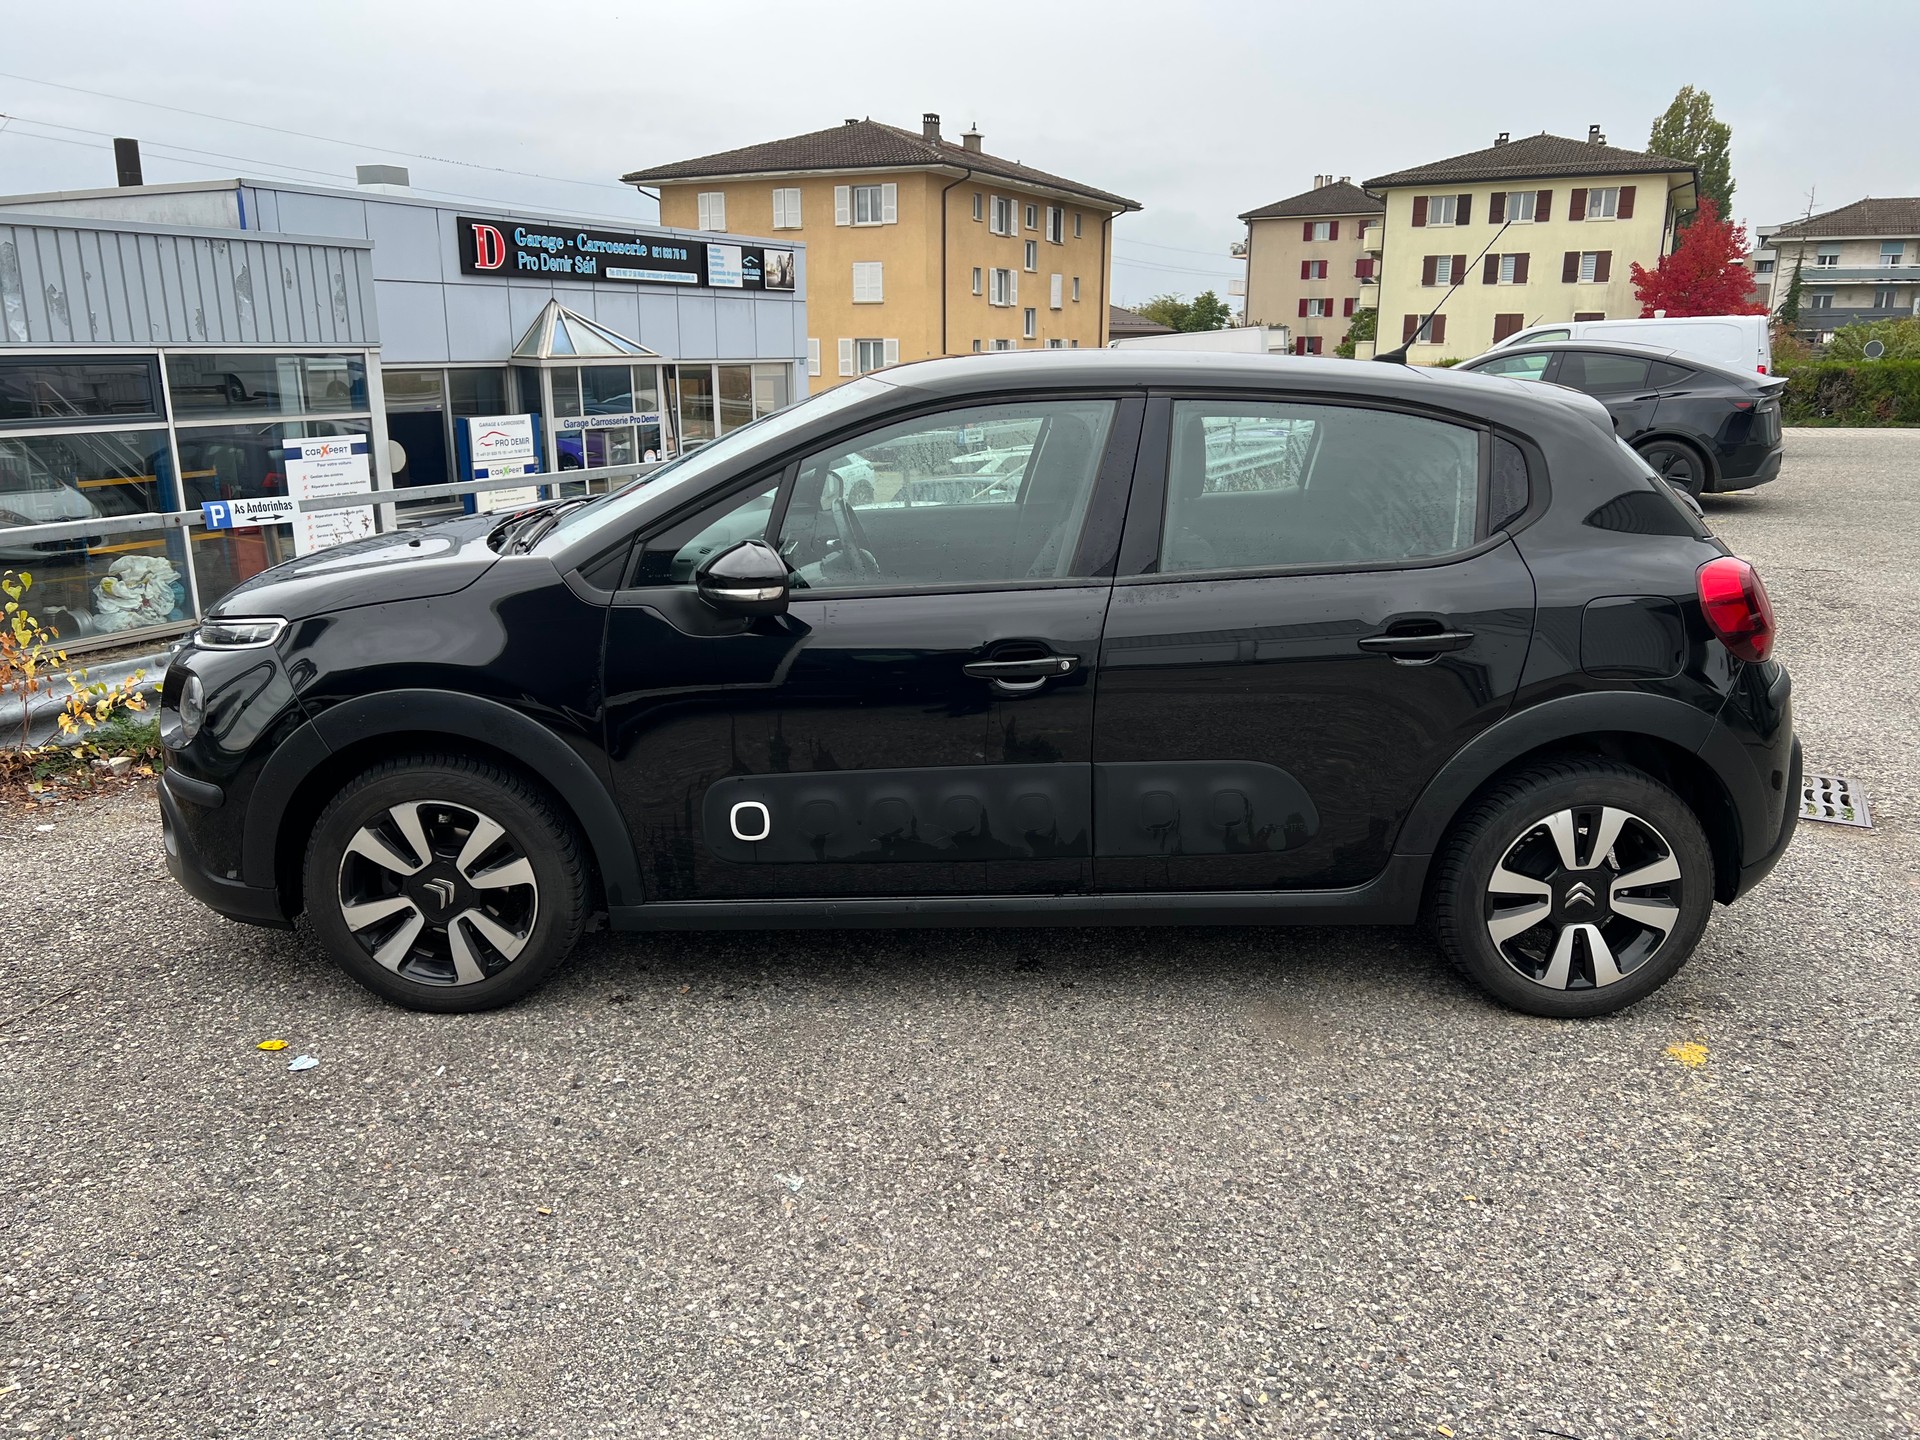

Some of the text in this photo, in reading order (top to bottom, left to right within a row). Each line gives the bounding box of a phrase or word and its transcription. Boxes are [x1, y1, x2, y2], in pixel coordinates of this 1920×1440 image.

[471, 223, 506, 270] D
[514, 227, 565, 254] Garage
[576, 233, 648, 257] Carrosserie
[517, 251, 539, 271] Pro
[540, 252, 573, 273] Demir
[563, 414, 659, 430] Garage Carrosserie Pro Demir
[495, 437, 530, 447] PRO DEMIR
[209, 505, 225, 527] P
[234, 499, 294, 515] As Andorinhas
